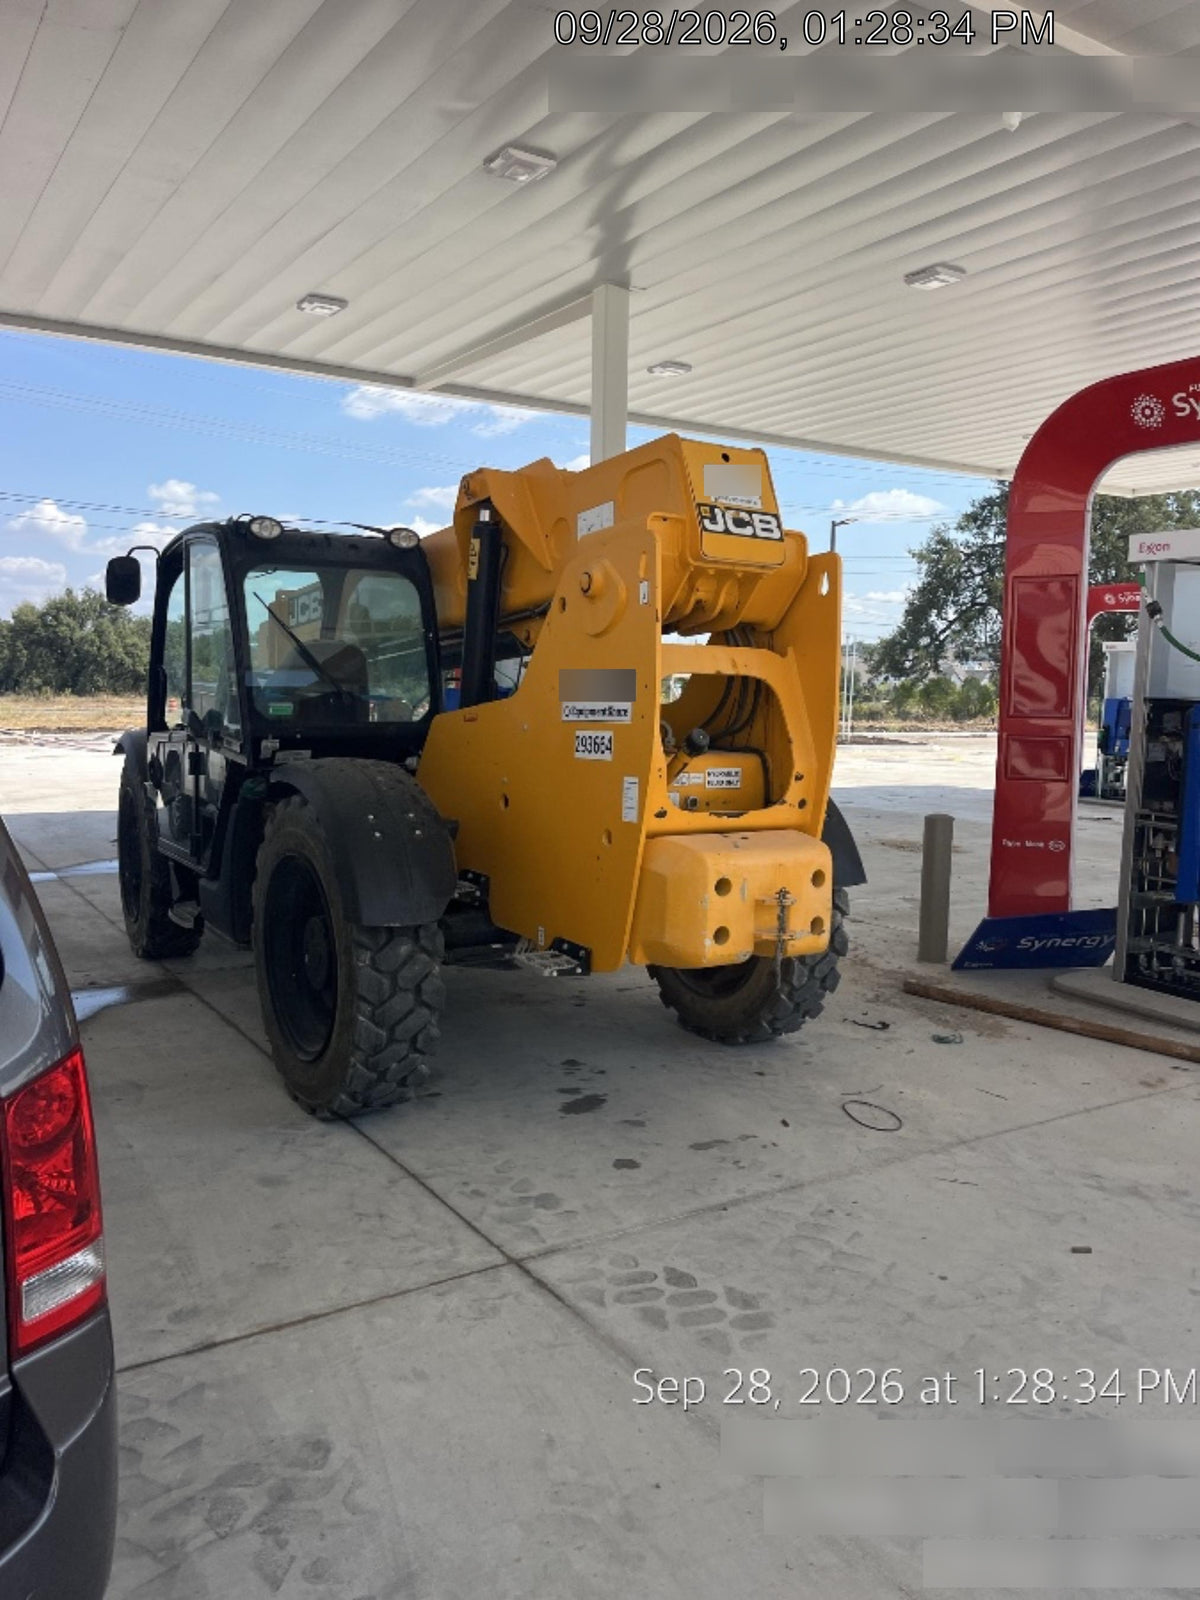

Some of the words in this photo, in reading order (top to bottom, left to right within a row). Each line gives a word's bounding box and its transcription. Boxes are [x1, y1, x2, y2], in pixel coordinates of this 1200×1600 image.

[702, 507, 781, 540] JCB
[1139, 541, 1171, 555] Exxon
[575, 735, 613, 754] 293664
[1016, 934, 1116, 951] Synergy
